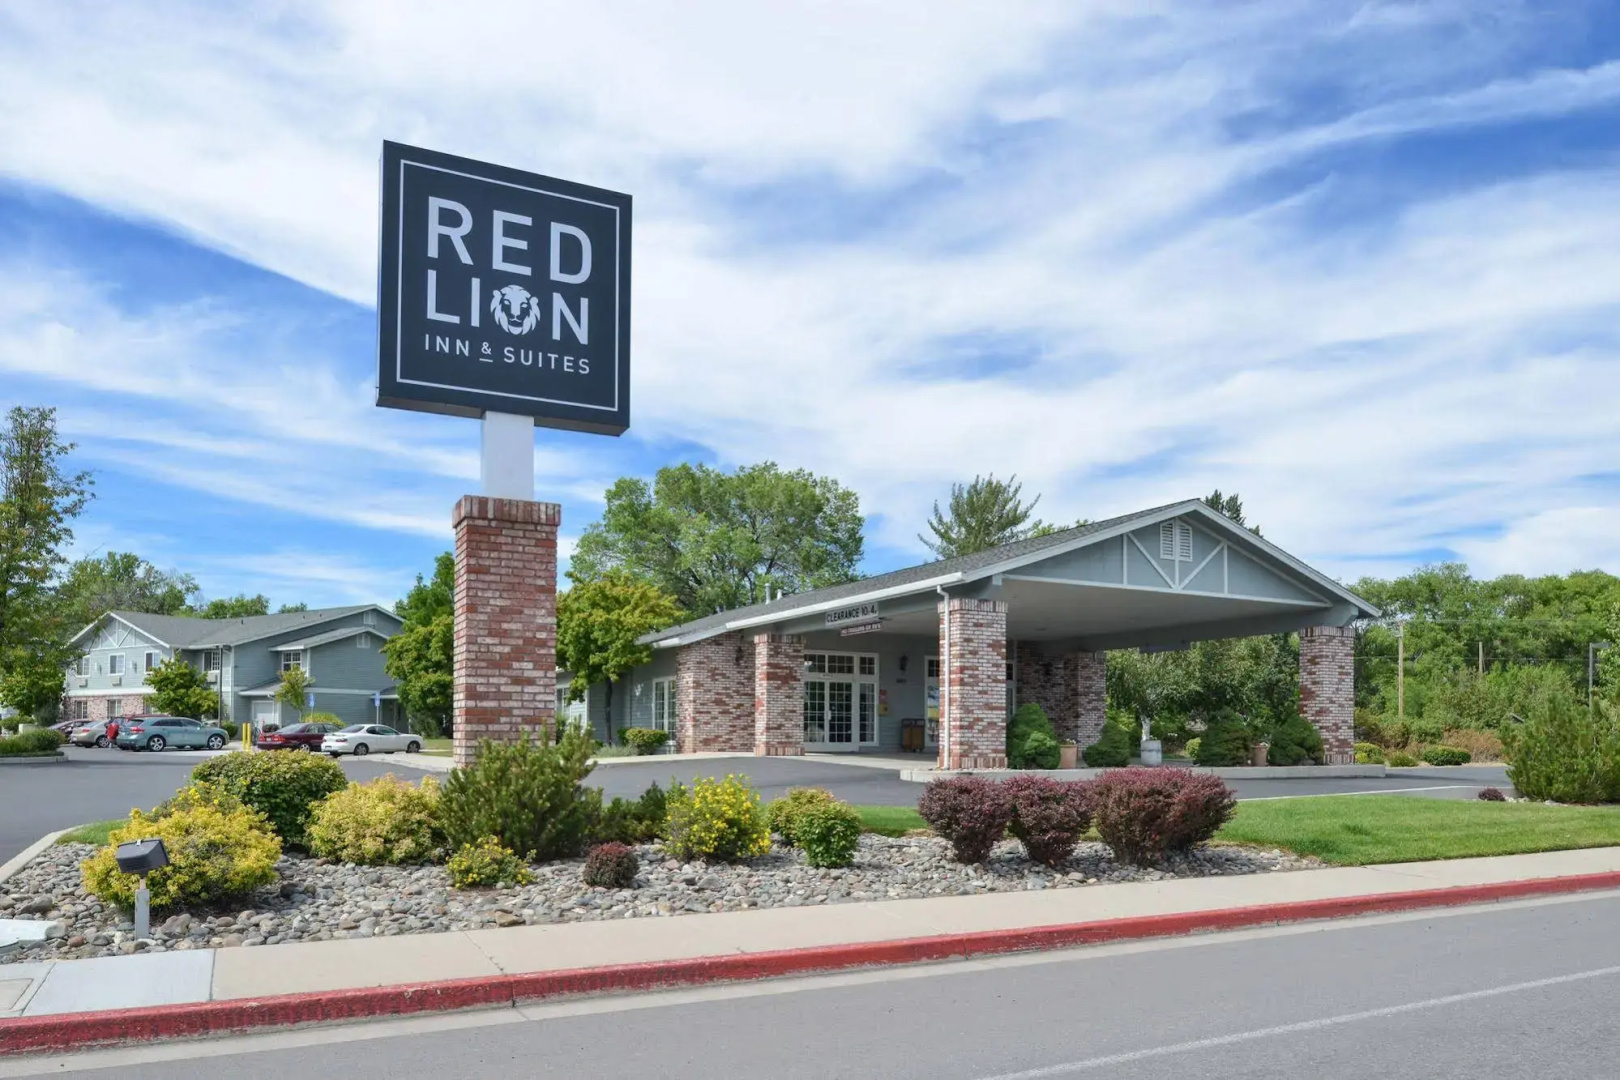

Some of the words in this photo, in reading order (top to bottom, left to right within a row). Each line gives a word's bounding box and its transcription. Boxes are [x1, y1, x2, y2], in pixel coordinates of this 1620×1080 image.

[427, 195, 592, 284] RED
[425, 333, 470, 357] INN
[480, 341, 493, 359] &
[503, 346, 590, 375] SUITES
[826, 607, 860, 623] CLEARANCE
